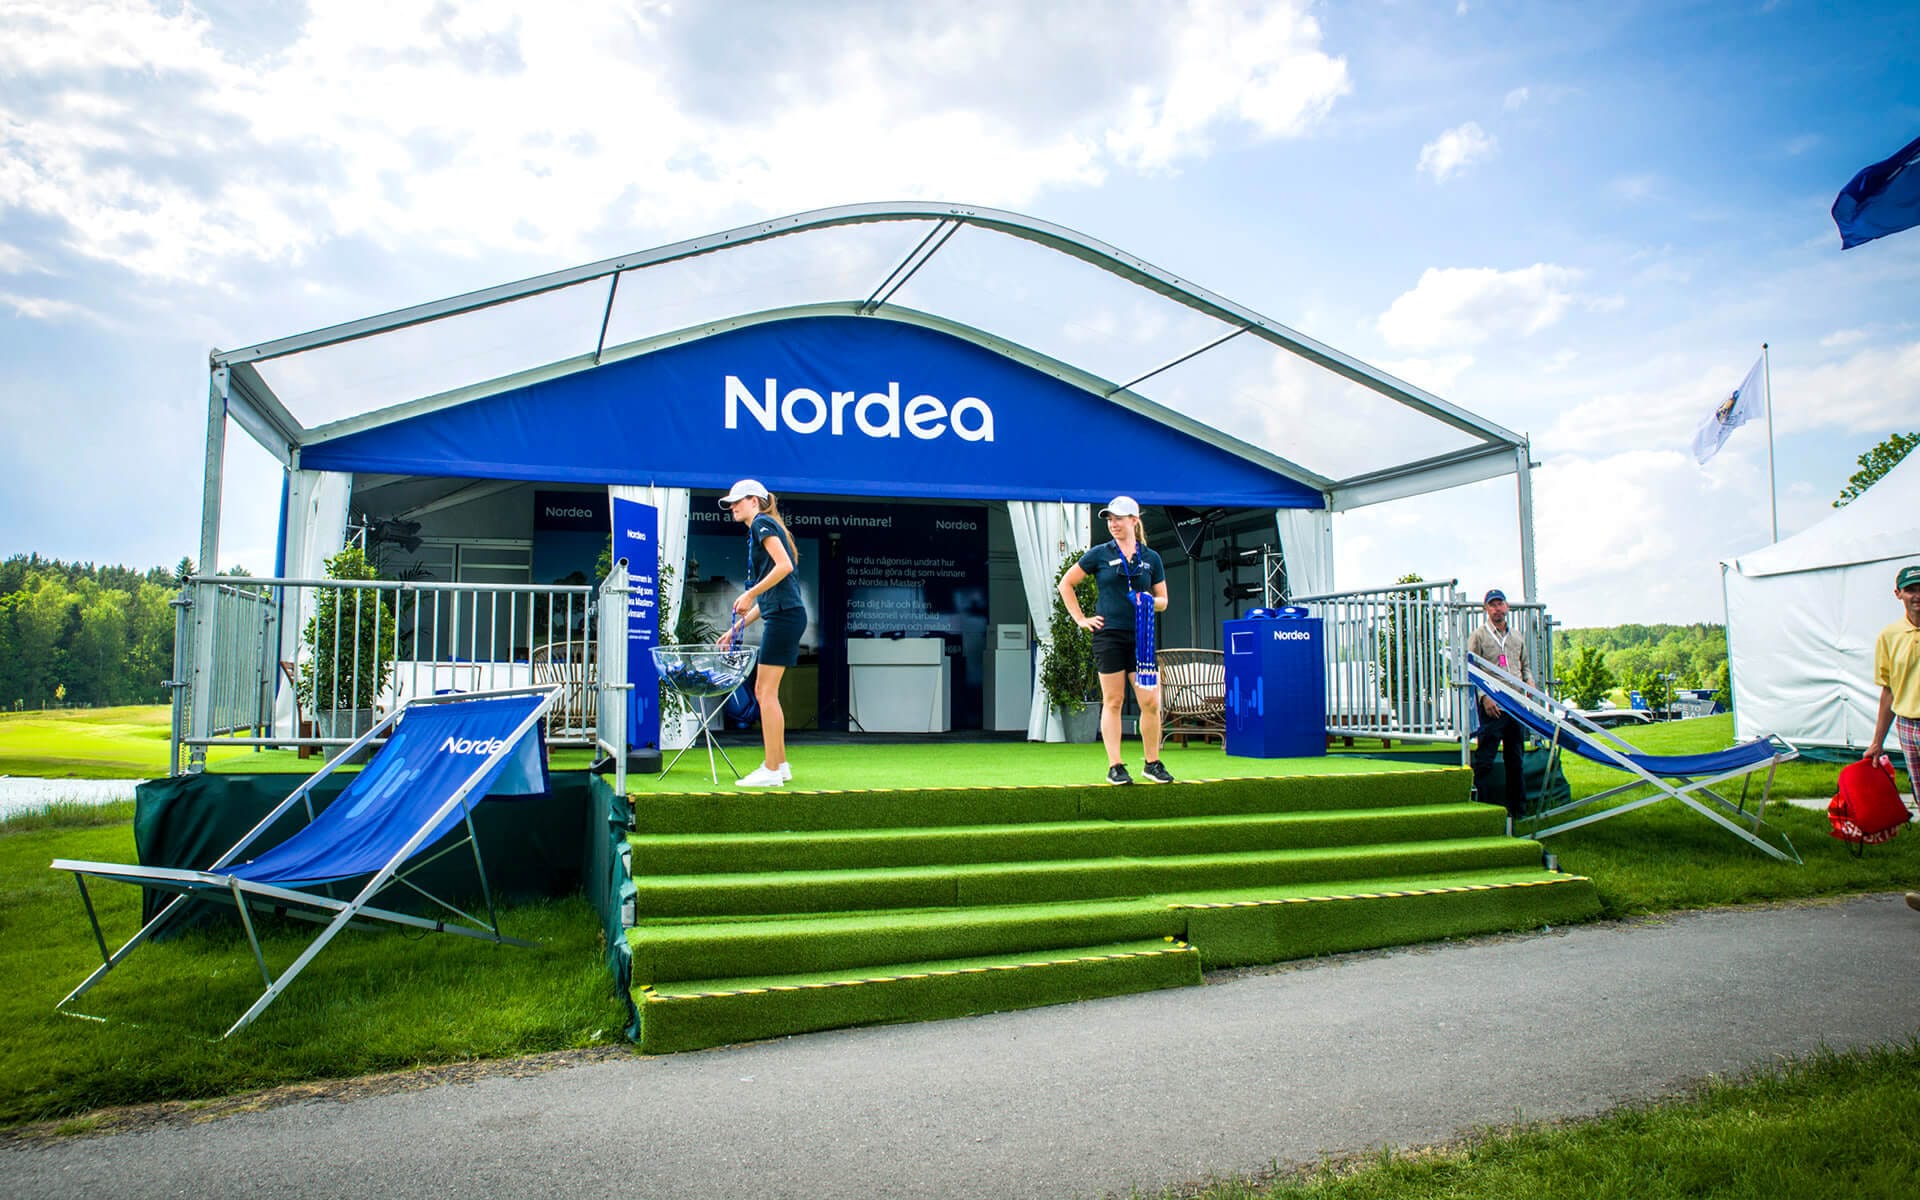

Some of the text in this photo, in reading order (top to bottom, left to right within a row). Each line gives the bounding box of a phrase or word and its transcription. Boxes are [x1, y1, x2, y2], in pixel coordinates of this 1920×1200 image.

[725, 375, 994, 442] Nordea
[545, 506, 593, 518] Nordea
[794, 515, 822, 526] som
[823, 514, 840, 526] en
[842, 514, 892, 527] vinnare!
[936, 519, 977, 530] Nordea
[626, 528, 647, 541] Nordea
[847, 555, 955, 568] Har du någonsin undrat hur
[847, 567, 967, 578] du skulle göra dig som vinnare
[858, 578, 888, 587] Nordea
[890, 578, 926, 588] Masters?
[847, 599, 865, 609] Fota
[866, 599, 880, 610] dig
[881, 599, 893, 609] här
[895, 600, 911, 609] och
[1273, 630, 1310, 641] Nordea
[440, 736, 509, 754] Norde
